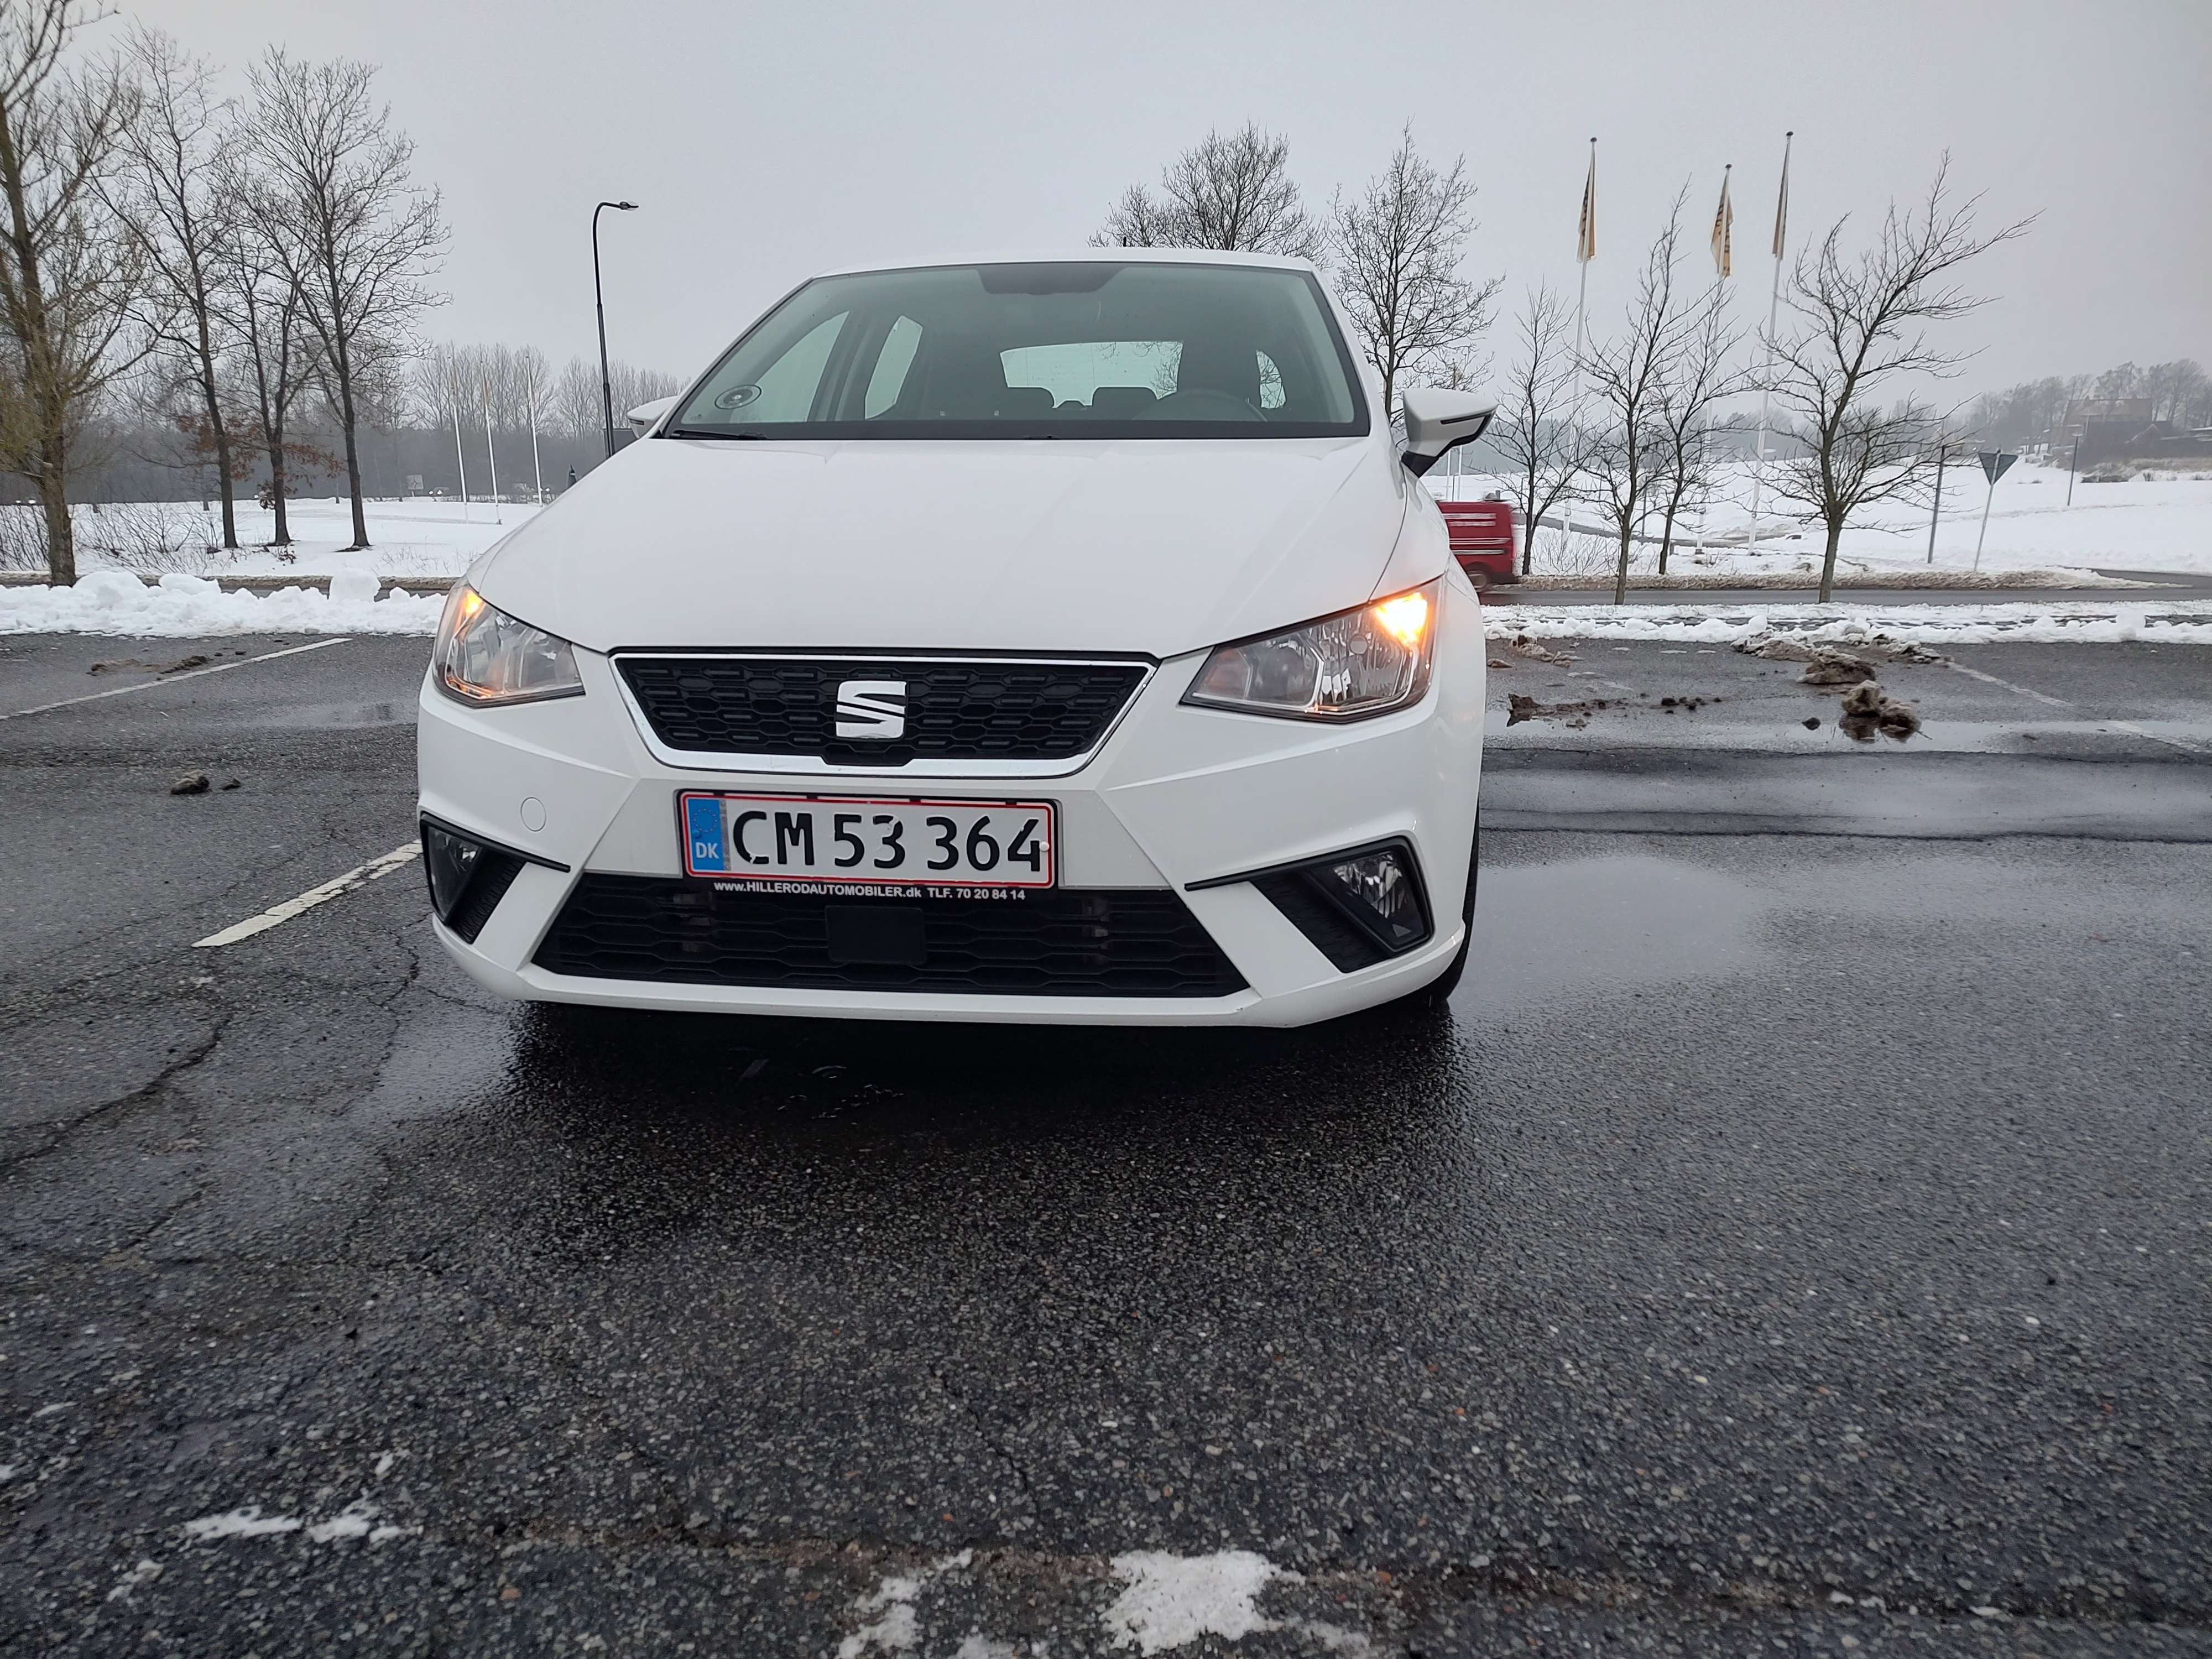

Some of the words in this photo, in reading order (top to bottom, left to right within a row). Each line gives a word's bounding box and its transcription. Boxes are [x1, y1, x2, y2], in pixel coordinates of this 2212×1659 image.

[696, 842, 719, 859] DK
[733, 811, 814, 865] CM
[834, 814, 905, 868] 53
[927, 816, 1040, 872] 364
[714, 881, 922, 898] www.HILLERODAUTOMOBILER.dk
[927, 887, 953, 898] TLF.
[957, 888, 971, 899] 70
[974, 889, 989, 899] 20
[992, 889, 1007, 900] 84
[1010, 889, 1026, 900] 14
